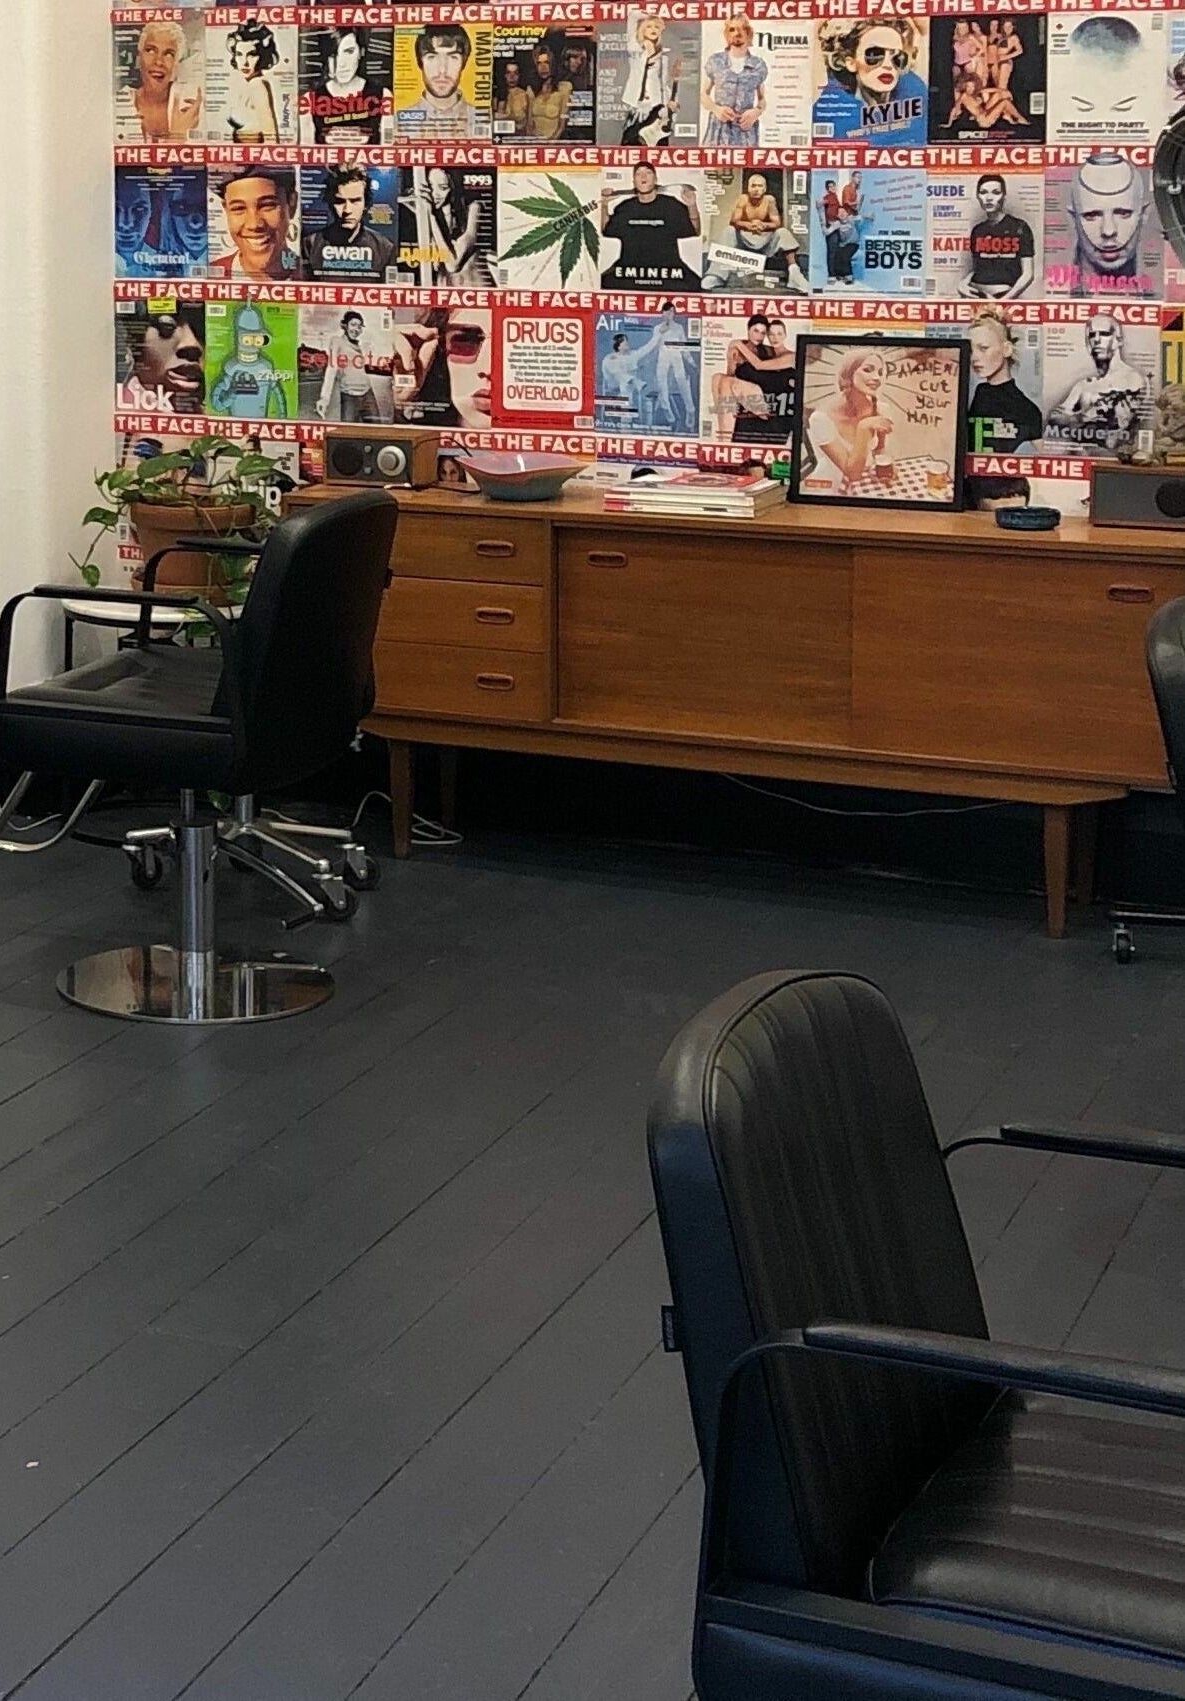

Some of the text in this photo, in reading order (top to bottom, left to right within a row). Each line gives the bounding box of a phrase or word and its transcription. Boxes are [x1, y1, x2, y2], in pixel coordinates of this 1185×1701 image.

[395, 6, 493, 22] THE FACE
[494, 5, 595, 21] THE FACE
[601, 4, 700, 19] THE FACE
[703, 2, 812, 18] THE FACE
[815, 0, 927, 16] THE FACE
[929, 0, 1045, 13] THE FACE
[115, 9, 182, 22] THE FACE
[205, 8, 297, 23] THE FACE
[299, 9, 393, 24] THE FACE
[494, 26, 547, 39] Courtney
[475, 31, 492, 67] MAD
[475, 72, 491, 101] FOR
[299, 91, 394, 116] elastica
[862, 98, 922, 126] KYLIE
[116, 148, 205, 163] THE FACE
[207, 147, 298, 163] THE FACE
[301, 148, 394, 164] THE FACE
[394, 149, 496, 164] THE FACE
[498, 149, 599, 164] THE FACE
[601, 149, 703, 165] THE FACE
[704, 149, 813, 166] THE FACE
[816, 149, 925, 166] THE FACE
[927, 148, 1045, 165] THE FACE
[1045, 147, 1155, 165] THE AC
[463, 174, 493, 186] 1993
[926, 185, 965, 197] SUEDE
[553, 199, 599, 232] CANNABIS
[322, 245, 373, 261] ewan
[865, 240, 923, 252] BEASTIE
[933, 237, 1020, 252] KATE MOSS
[715, 249, 759, 267] eminem
[865, 251, 923, 270] BOYS
[615, 267, 685, 279] EMINEM
[116, 282, 203, 298] THE FACE
[208, 284, 296, 301] THE FACE
[299, 287, 394, 304] THE FACE
[394, 289, 489, 307] THE FACE
[493, 291, 593, 308] THE FACE
[596, 295, 702, 313] THE FACE
[702, 298, 810, 316] THE FACE
[813, 302, 923, 320] THE FACE
[925, 304, 1041, 321] THE CE
[1046, 304, 1091, 321] THE
[596, 314, 622, 331] Air
[506, 320, 580, 344] DRUGS
[116, 383, 175, 411] Lick
[506, 384, 580, 401] OVERLOAD
[915, 395, 952, 410] your
[117, 416, 205, 434] THE FACE
[249, 423, 297, 440] FACE
[301, 425, 336, 440] TH
[440, 432, 496, 449] FACE
[496, 434, 596, 454] THE FACE
[597, 438, 698, 459] THE FACE
[701, 446, 744, 463] THE
[751, 448, 792, 464] FAC
[973, 458, 1034, 475] FACE
[1038, 459, 1084, 477] THE
